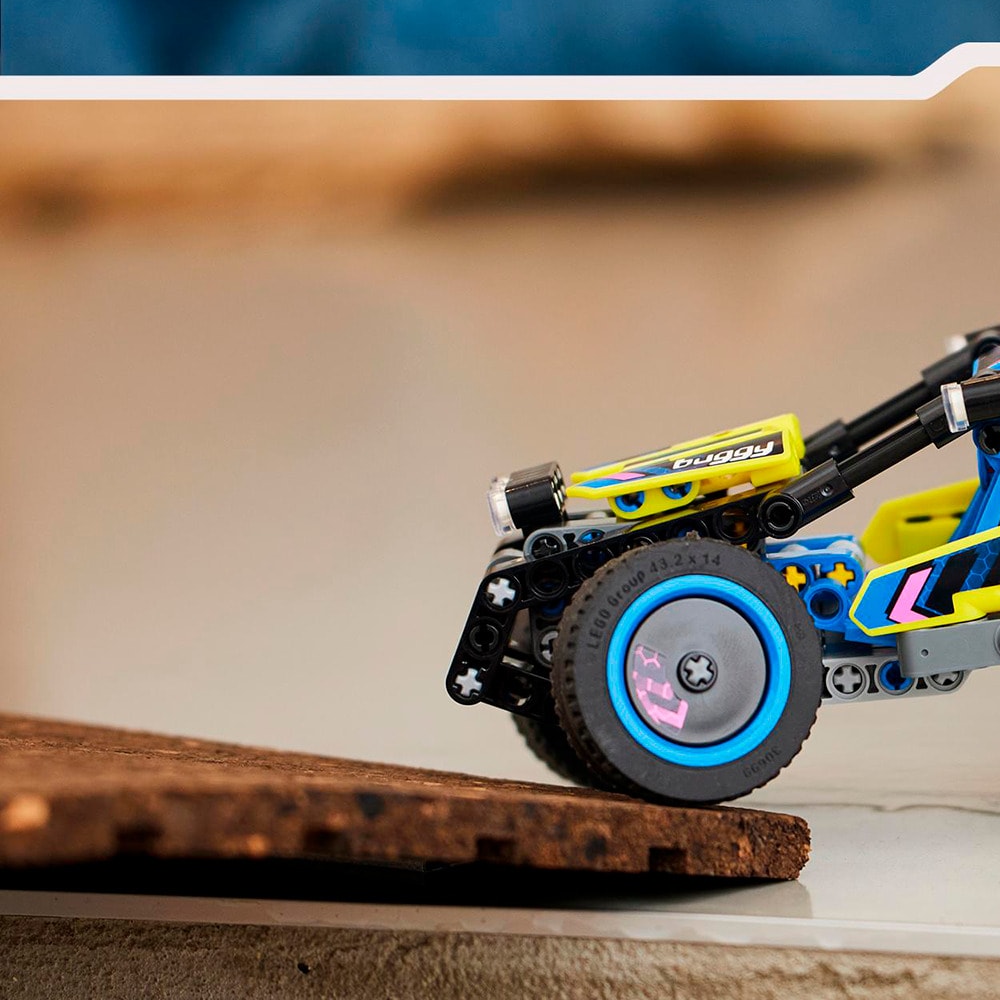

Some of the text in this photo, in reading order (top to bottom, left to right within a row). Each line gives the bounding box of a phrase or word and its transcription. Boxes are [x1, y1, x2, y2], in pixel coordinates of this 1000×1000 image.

[672, 440, 775, 470] buggy
[587, 553, 720, 649] LEGO Group 43.2 x 14
